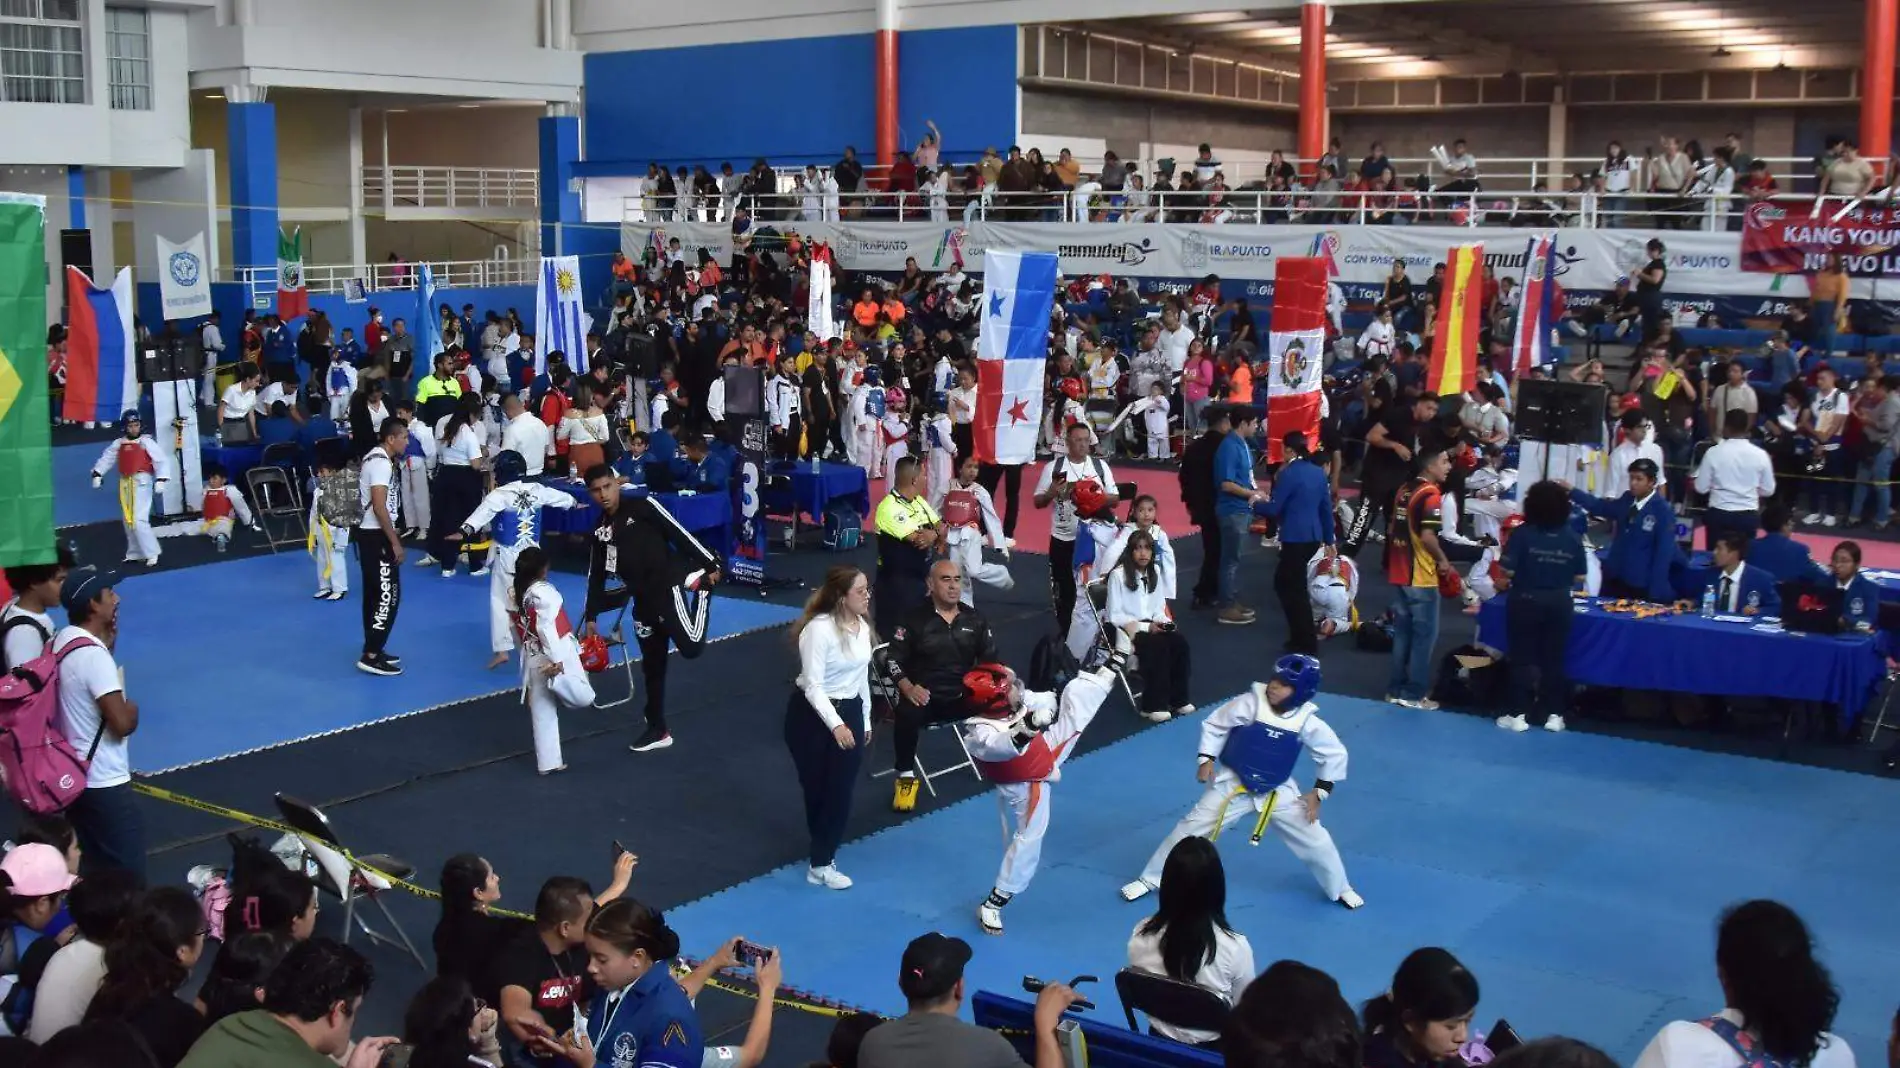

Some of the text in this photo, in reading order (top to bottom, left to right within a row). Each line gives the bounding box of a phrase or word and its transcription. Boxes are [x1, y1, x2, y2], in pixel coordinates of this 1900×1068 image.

[1783, 226, 1844, 245] KANG
[859, 243, 907, 253] IRAPUATO
[1209, 245, 1272, 258] IRAPUATO
[1344, 254, 1368, 264] CON
[1669, 253, 1731, 270] APUATO
[742, 462, 761, 520] 3
